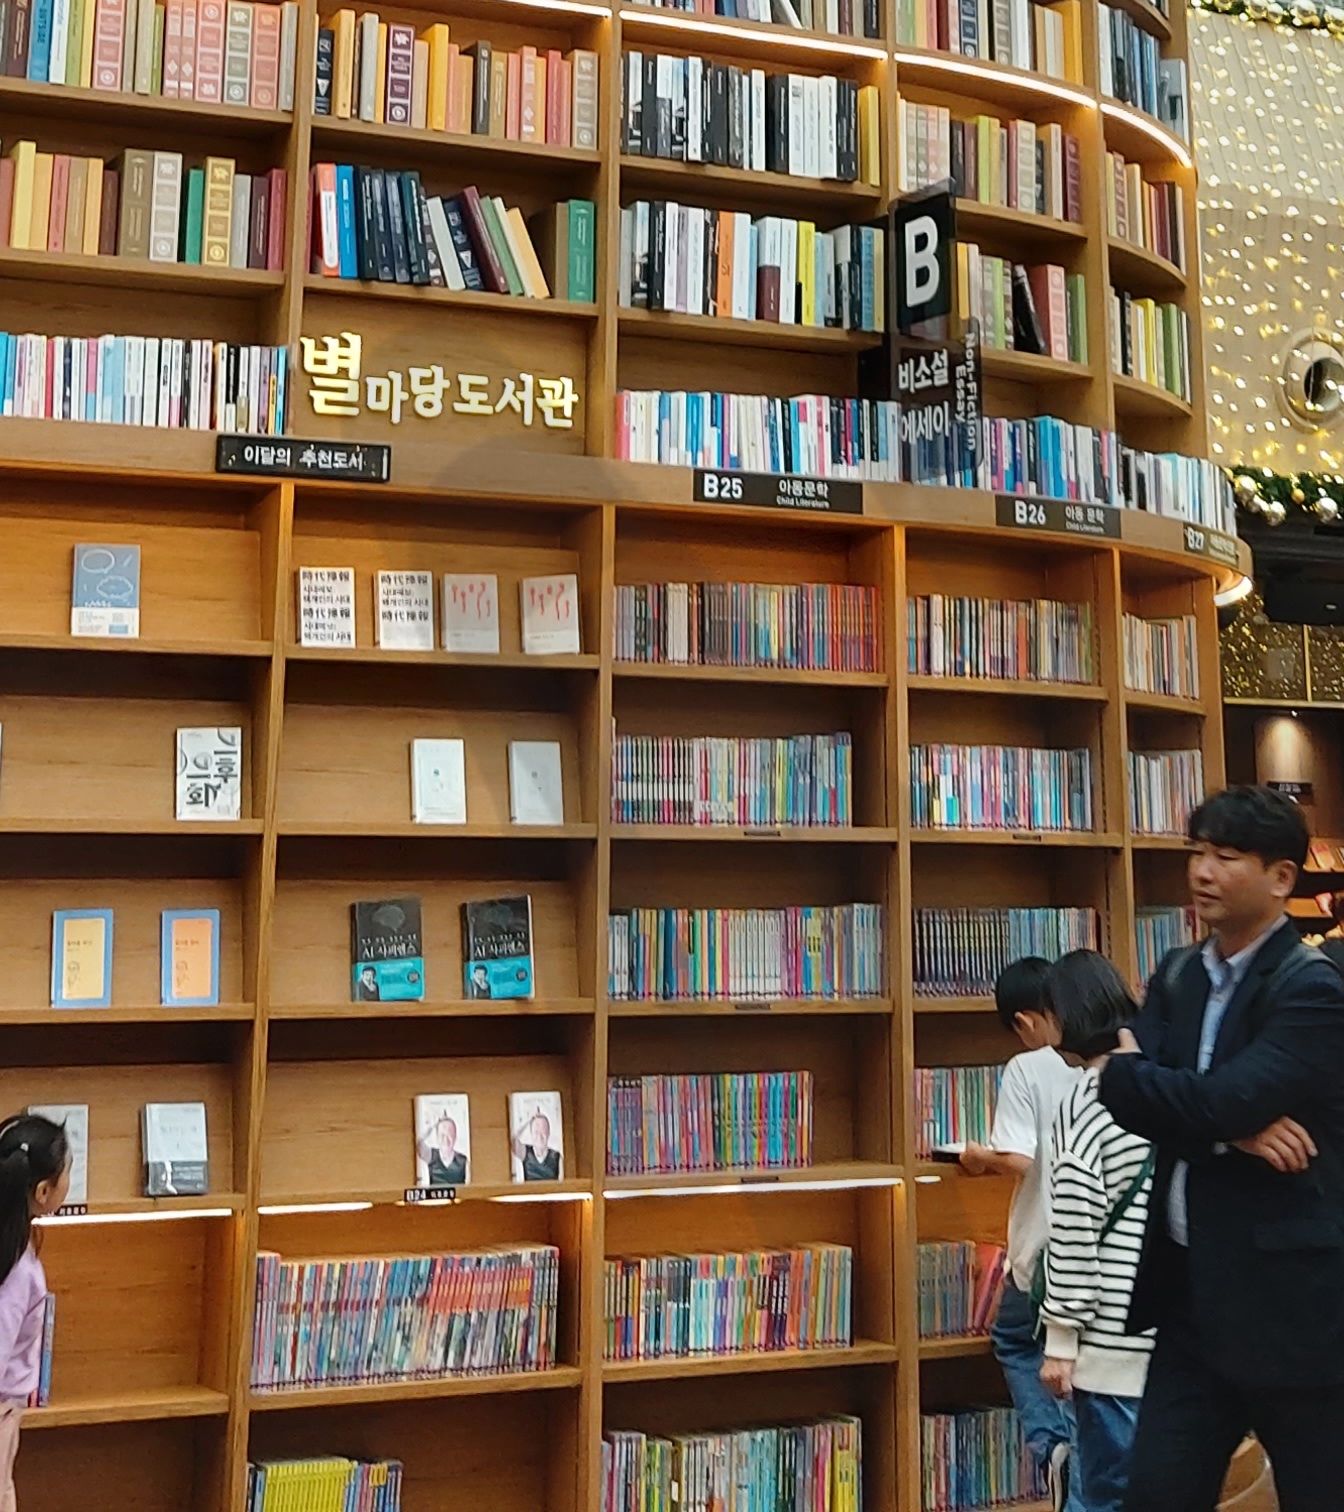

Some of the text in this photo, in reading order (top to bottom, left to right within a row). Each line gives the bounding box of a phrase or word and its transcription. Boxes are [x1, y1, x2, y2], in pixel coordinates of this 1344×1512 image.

[905, 215, 941, 309] B
[898, 348, 949, 393] 비소설
[956, 365, 967, 423] Essay
[965, 333, 978, 451] Non-Fiction
[901, 401, 949, 444] 에세이
[244, 443, 364, 472] 이달의 추천도서
[703, 473, 743, 499] B25
[779, 479, 829, 498] 아동문학
[1015, 500, 1047, 525] B26
[1187, 527, 1204, 549] B27
